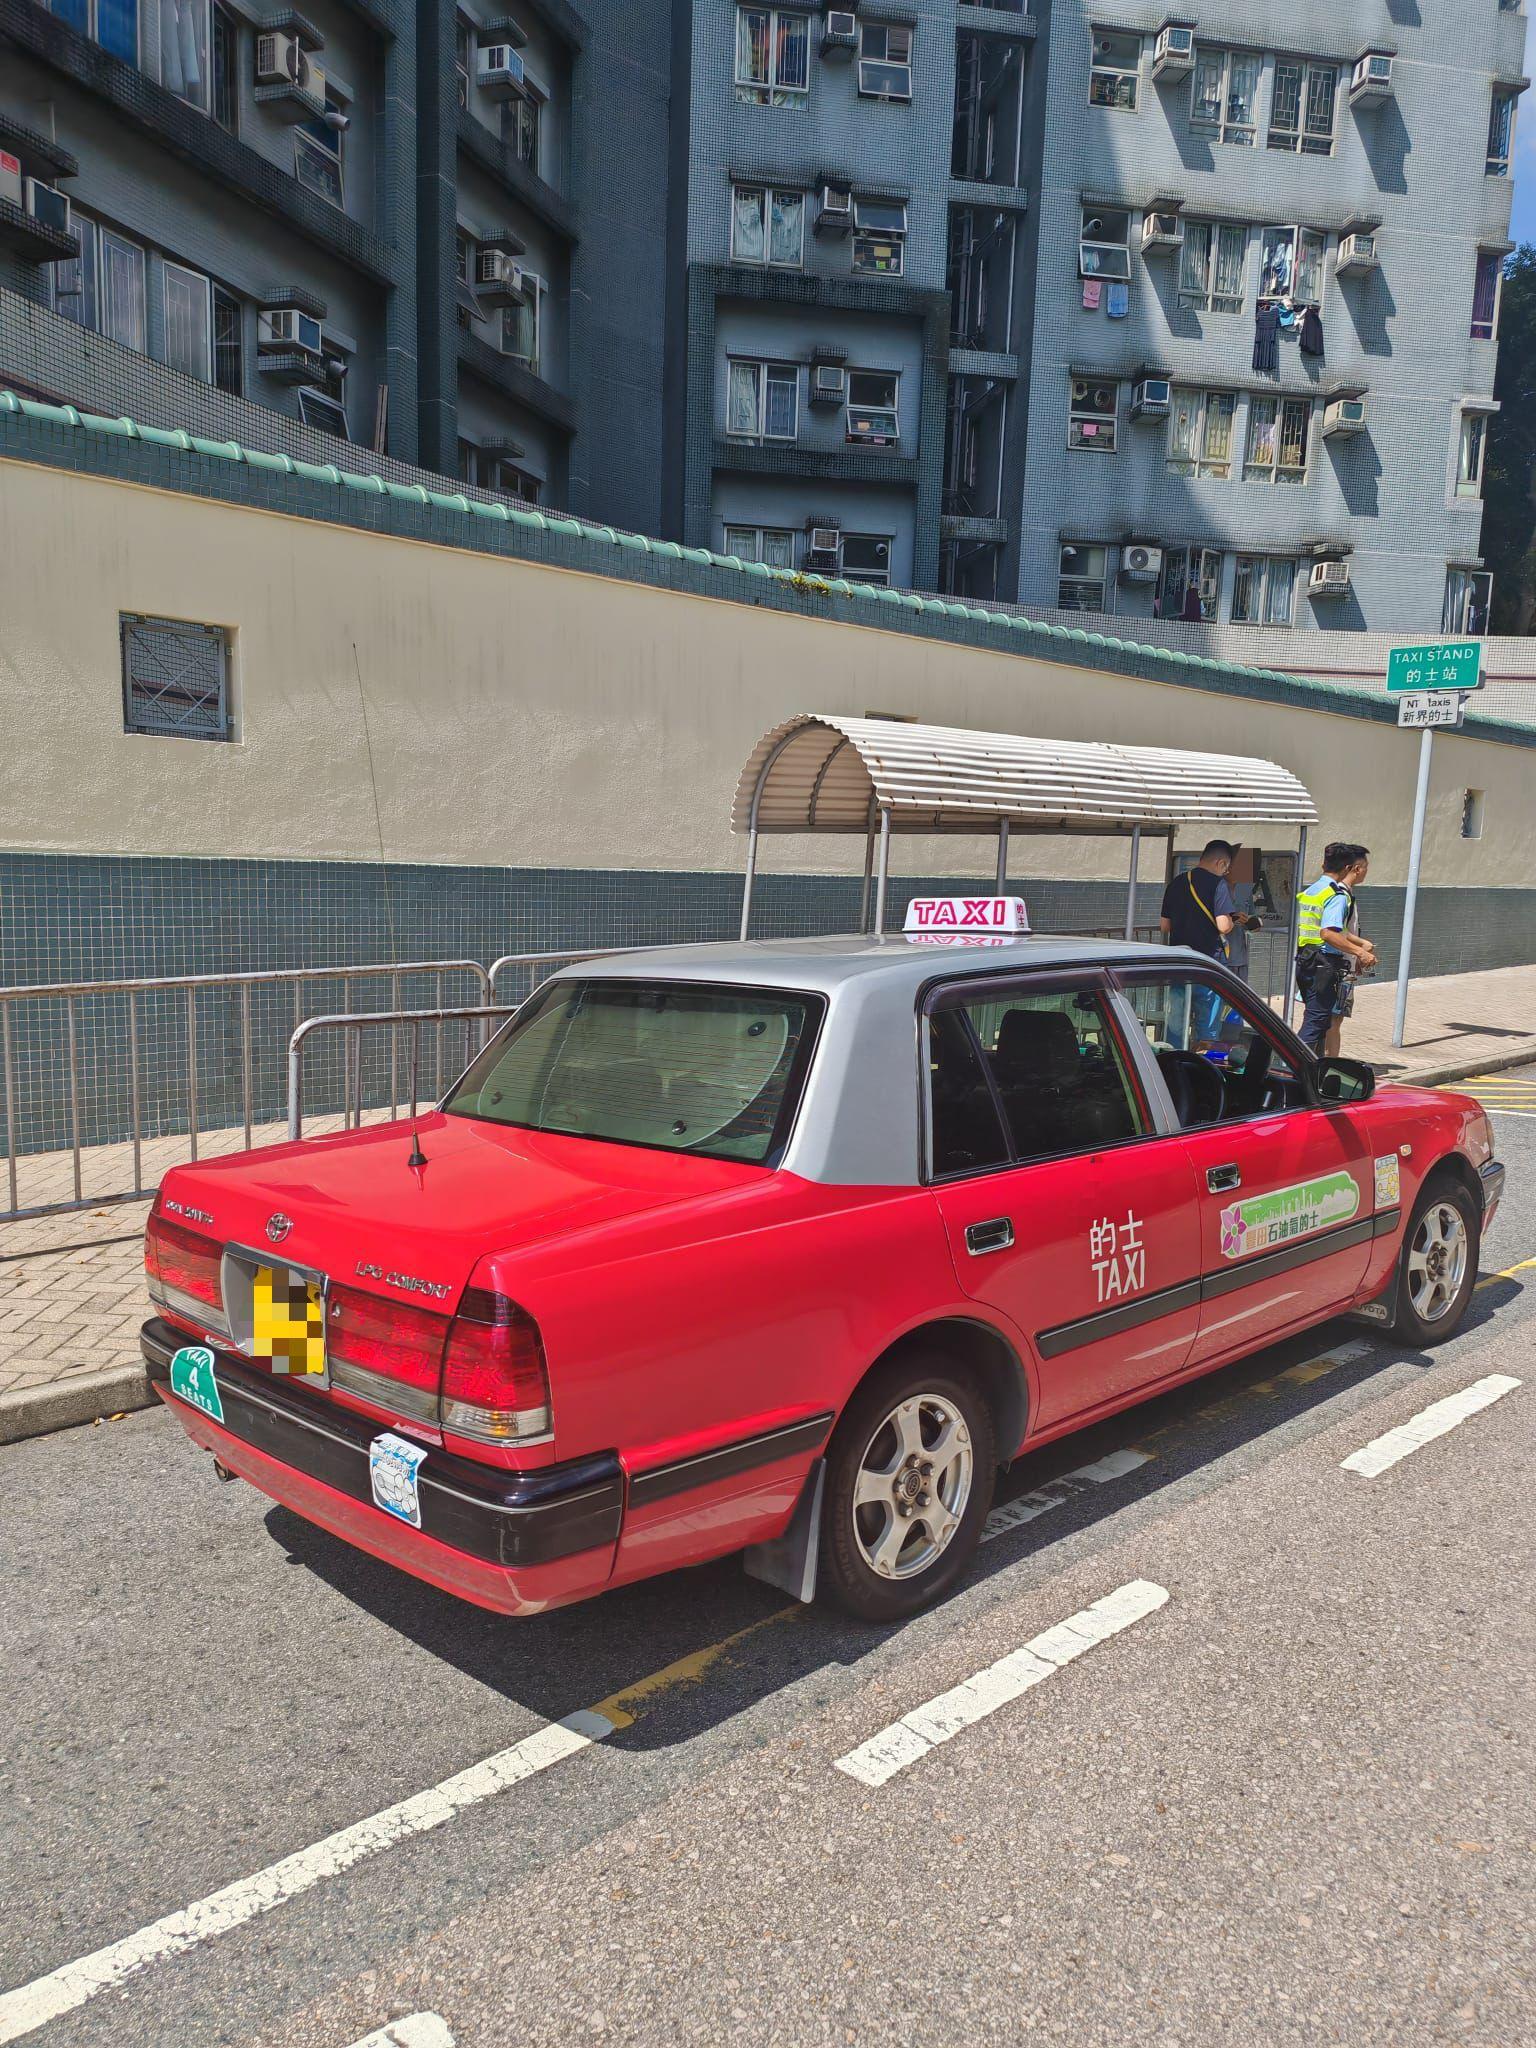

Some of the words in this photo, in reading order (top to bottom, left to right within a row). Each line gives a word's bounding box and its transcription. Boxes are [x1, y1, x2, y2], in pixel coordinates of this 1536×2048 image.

[1394, 652, 1423, 663] TAXI
[1427, 648, 1474, 662] STAND
[1406, 666, 1458, 683] 的士站
[1402, 709, 1454, 723] 新界的士
[1407, 700, 1420, 708] NT
[914, 900, 1006, 925] TAXI
[1090, 1209, 1143, 1260] 的士
[355, 1261, 383, 1279] LPG
[386, 1271, 452, 1299] COMFORT
[1092, 1249, 1145, 1302] TAXI
[189, 1366, 199, 1390] 4
[181, 1384, 212, 1410] SEATS
